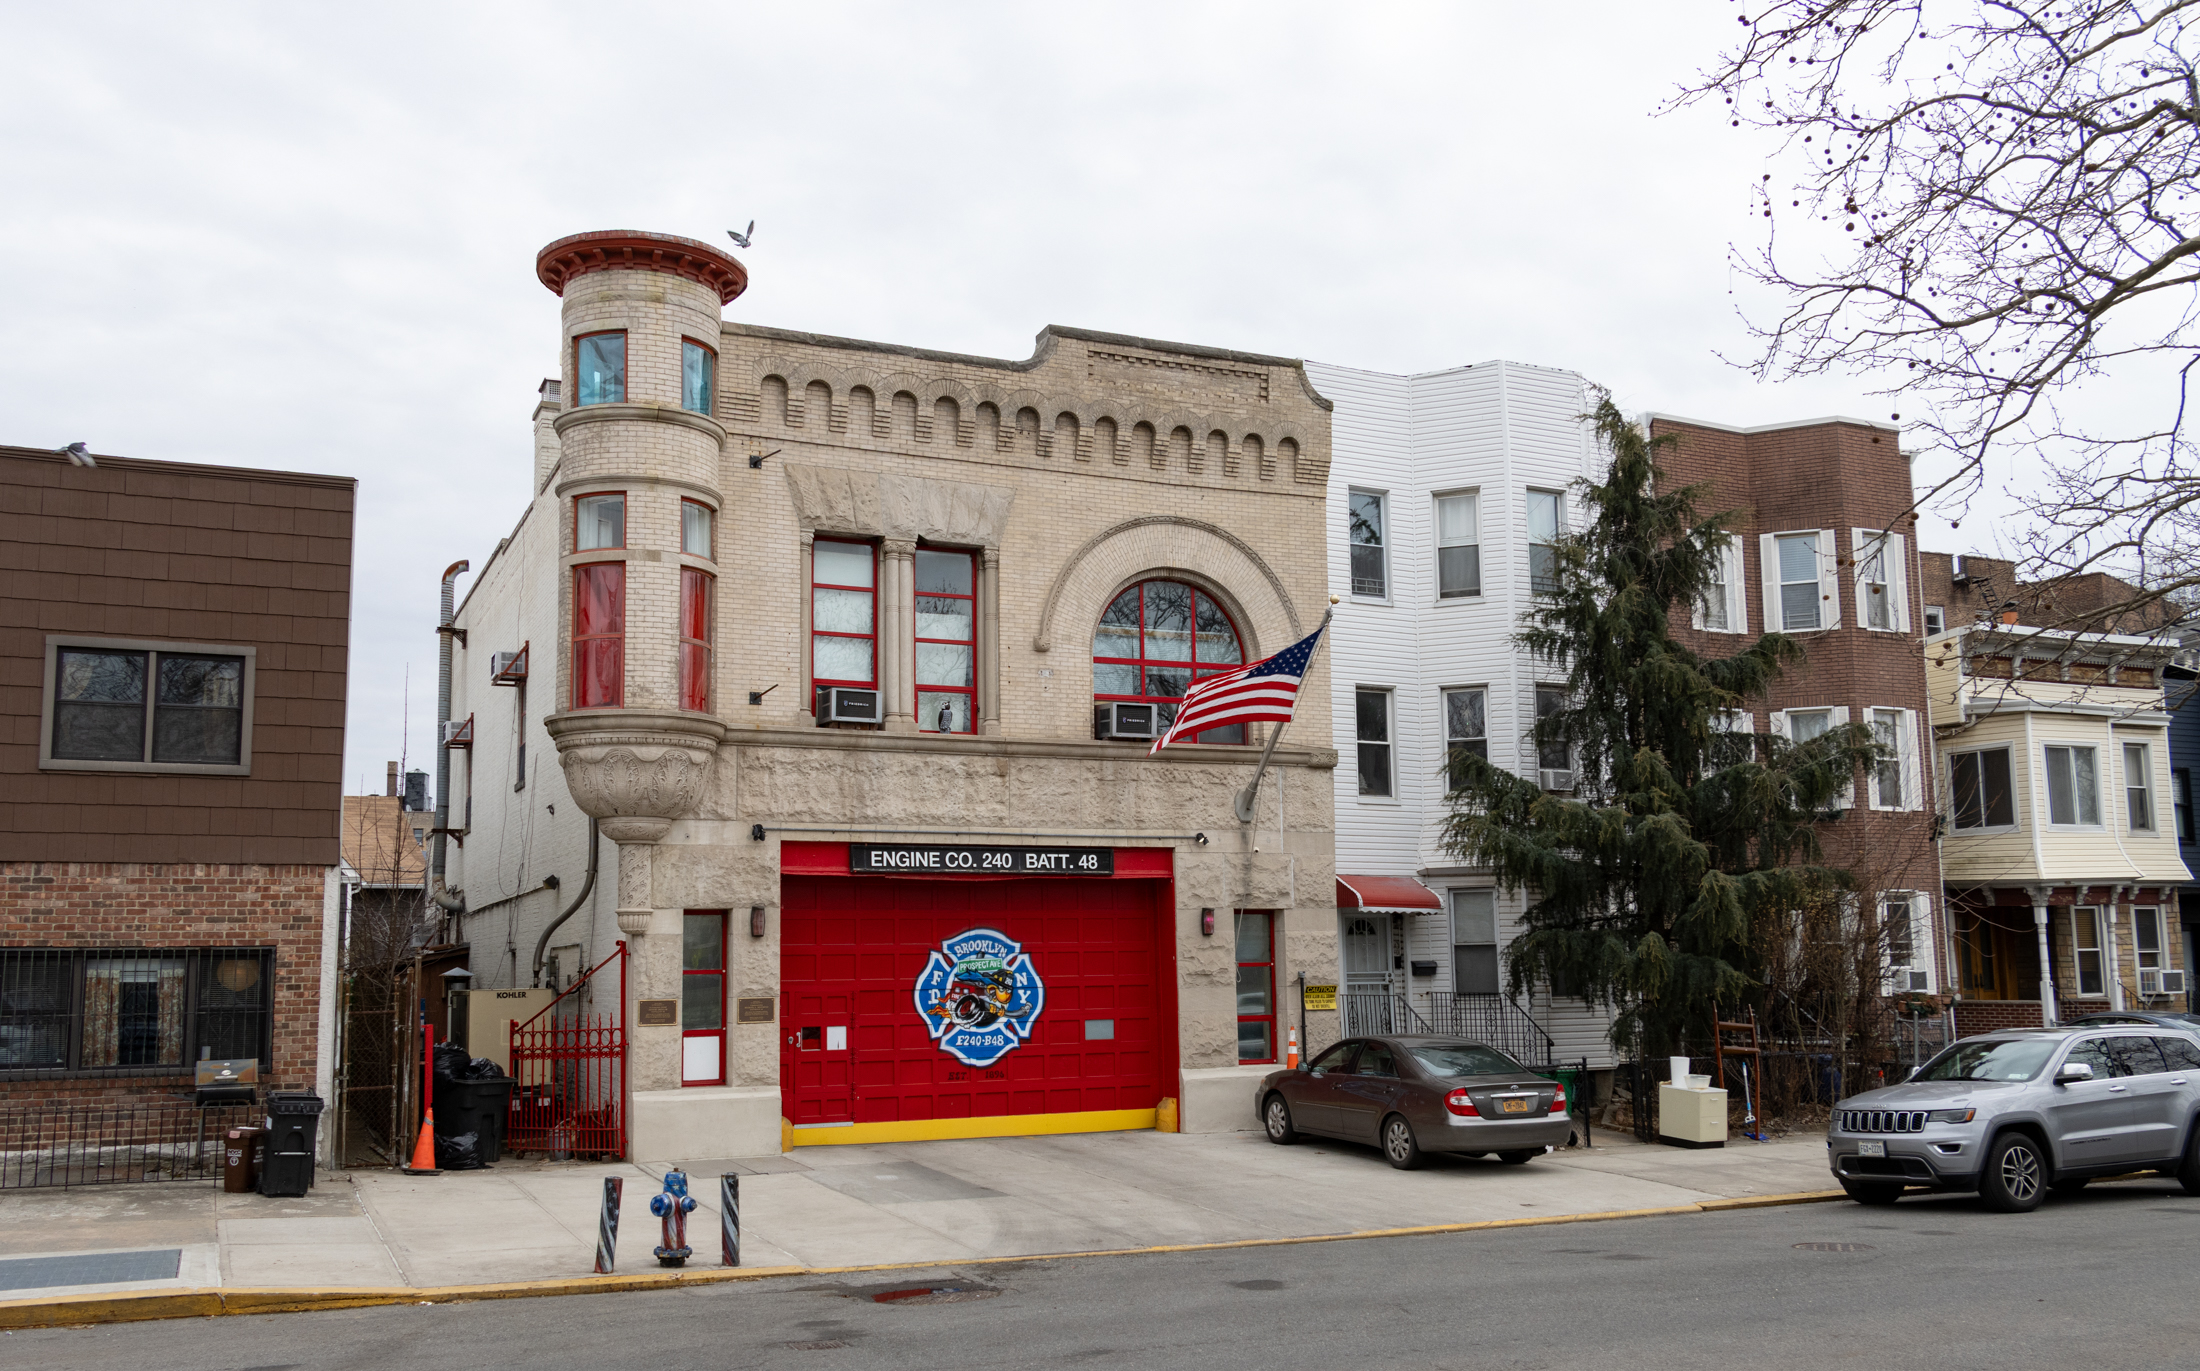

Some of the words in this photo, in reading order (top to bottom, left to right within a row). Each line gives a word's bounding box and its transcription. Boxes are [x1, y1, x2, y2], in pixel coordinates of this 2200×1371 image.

[871, 851, 940, 867] ENGINE
[945, 852, 977, 868] CO.
[982, 853, 1012, 868] 240
[1026, 853, 1073, 869] BATT.
[1079, 854, 1098, 869] 48
[954, 940, 1008, 958] BROOKLYN
[960, 961, 989, 971] PROSPECT
[990, 960, 1001, 968] AVE
[496, 991, 527, 999] KOHLER
[948, 1072, 969, 1081] EST.
